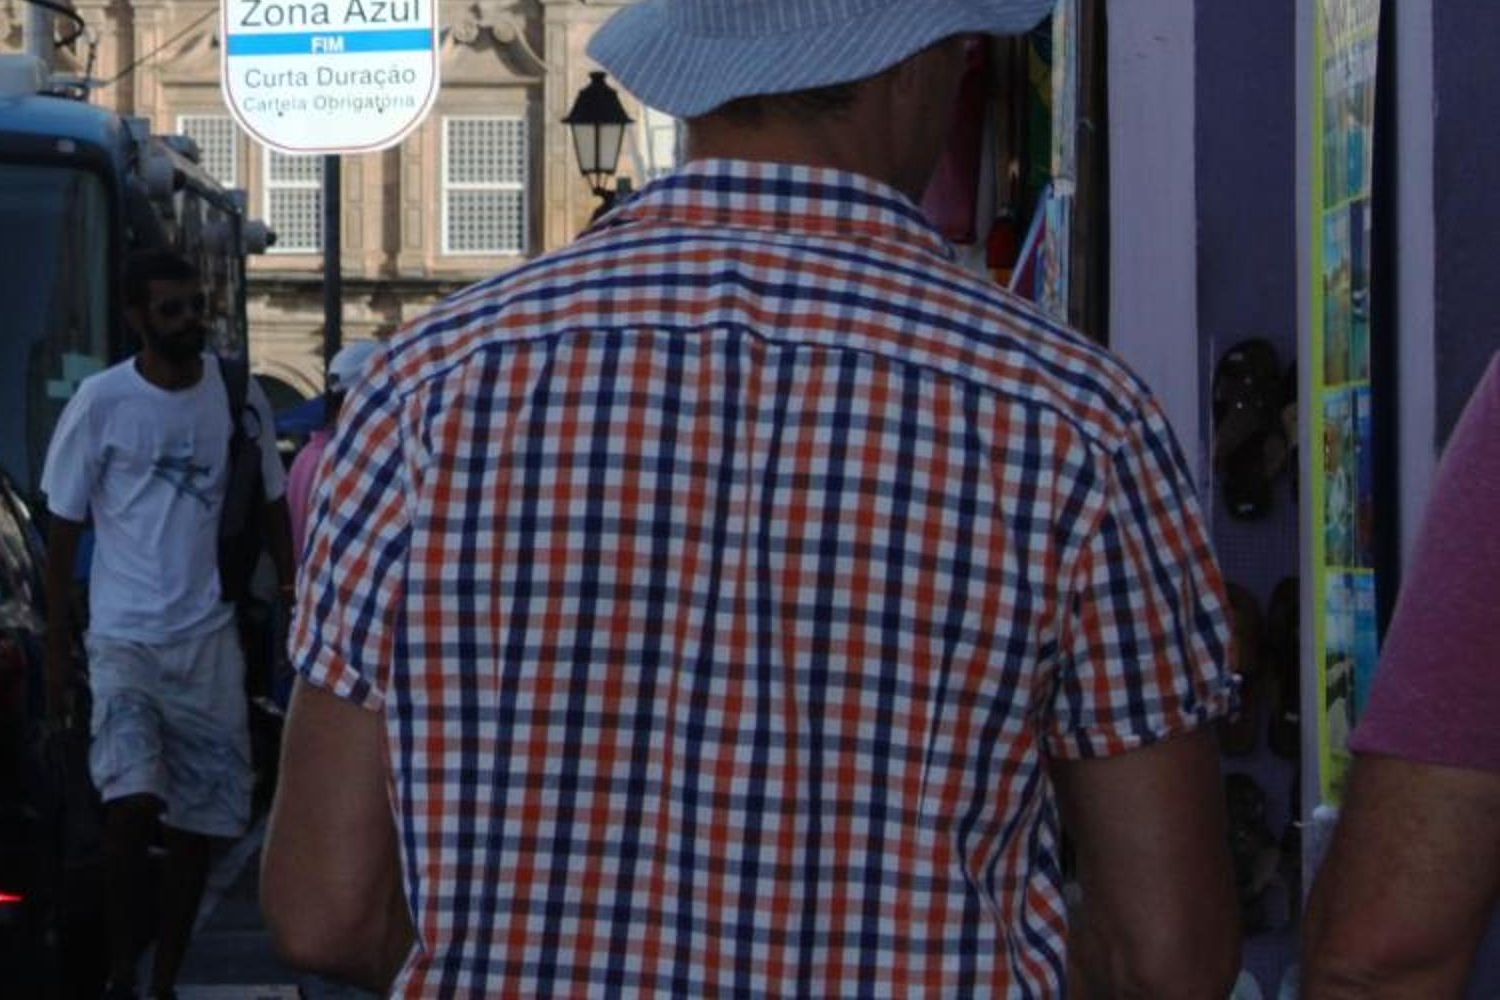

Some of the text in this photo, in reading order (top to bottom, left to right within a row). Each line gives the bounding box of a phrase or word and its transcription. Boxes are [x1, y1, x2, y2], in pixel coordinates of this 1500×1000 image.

[310, 36, 345, 54] FIM
[244, 64, 416, 90] Curta Duração
